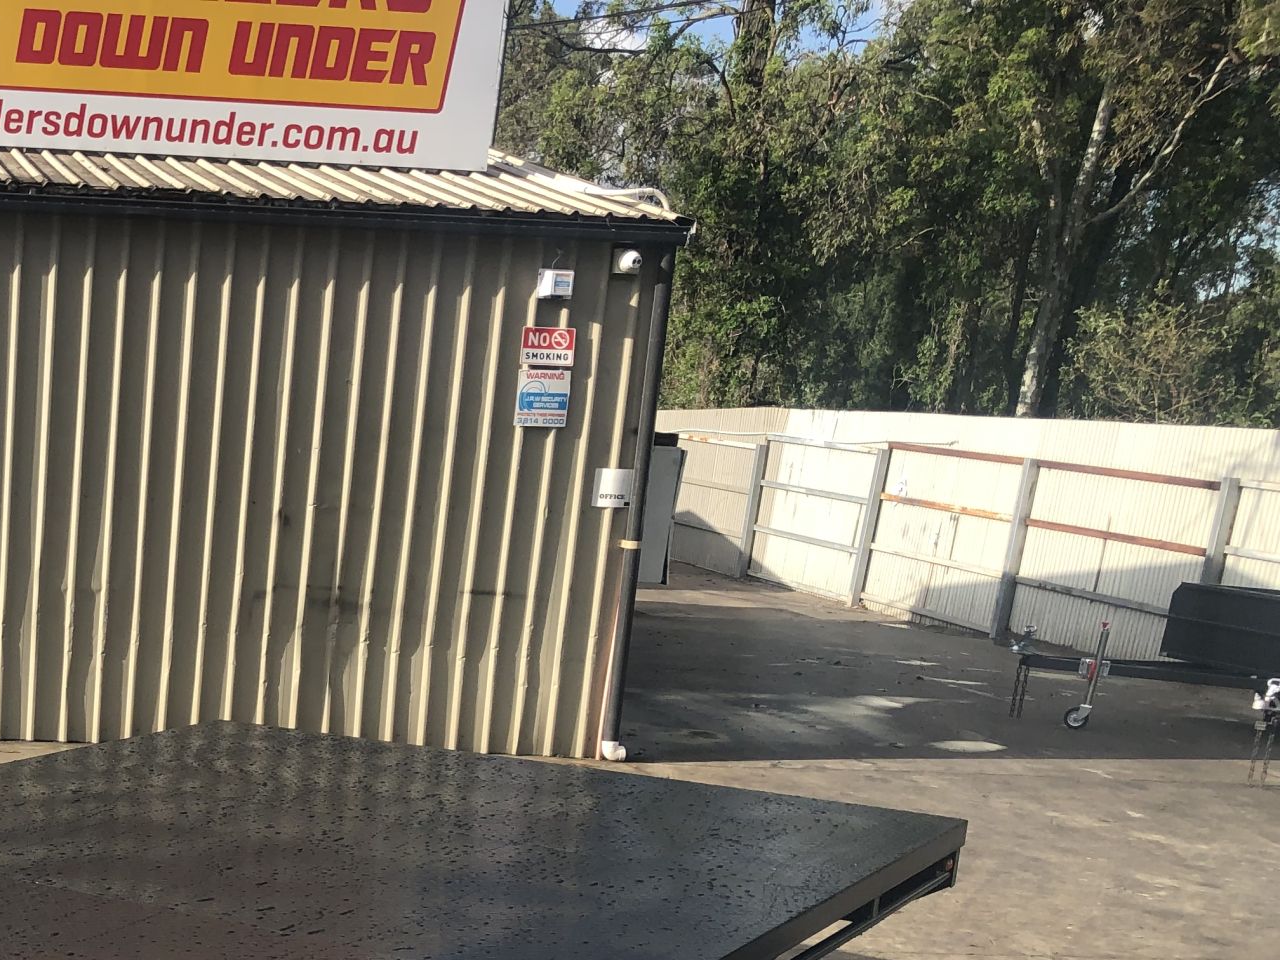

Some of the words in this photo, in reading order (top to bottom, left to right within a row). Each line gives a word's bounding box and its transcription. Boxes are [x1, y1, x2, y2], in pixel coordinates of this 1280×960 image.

[15, 8, 209, 73] DOWN
[228, 22, 437, 86] UNDER
[527, 331, 550, 347] NO
[525, 351, 569, 362] SMOKING
[527, 371, 565, 380] WARNING
